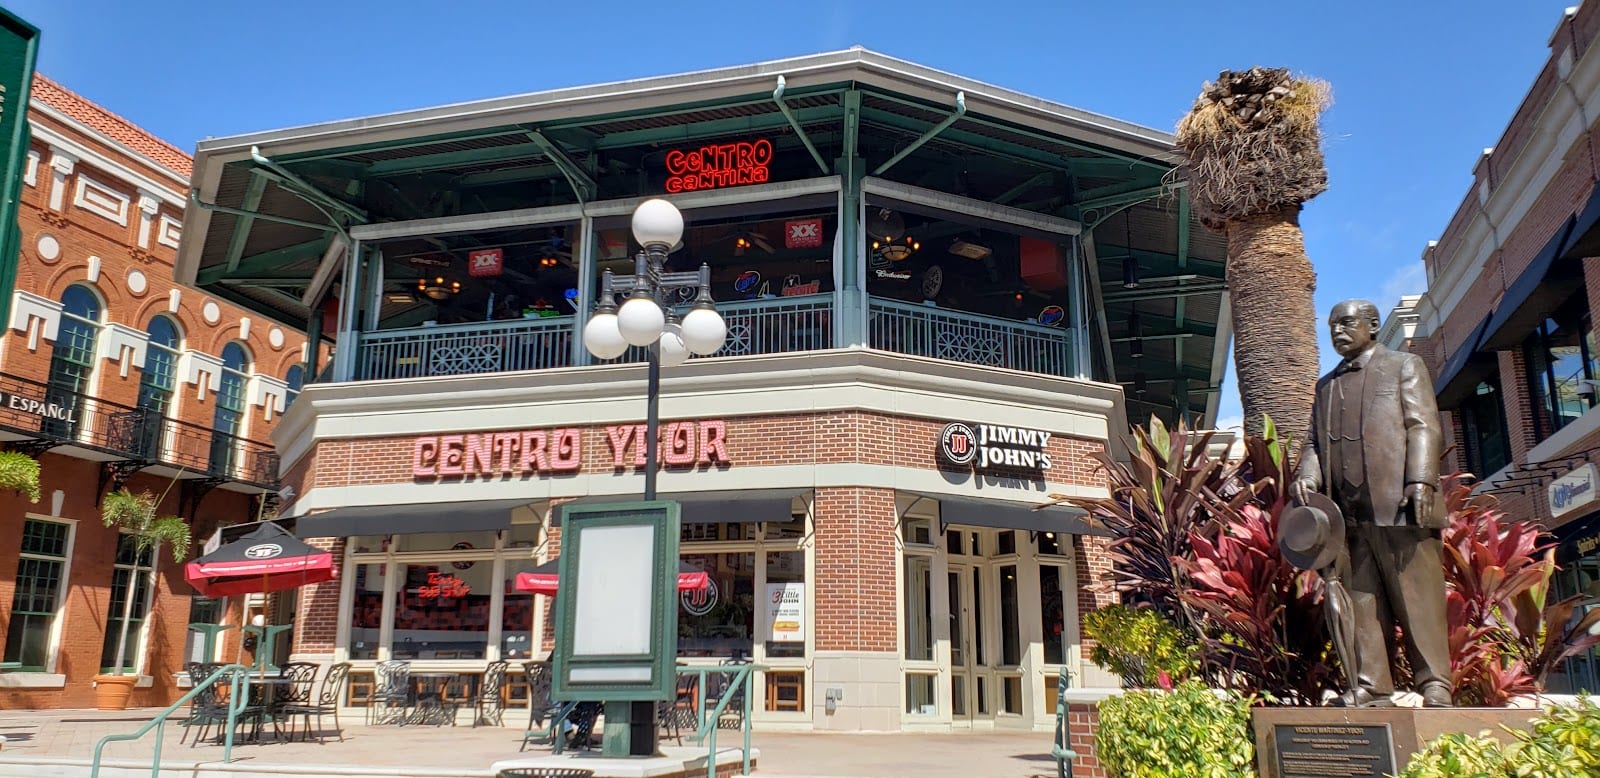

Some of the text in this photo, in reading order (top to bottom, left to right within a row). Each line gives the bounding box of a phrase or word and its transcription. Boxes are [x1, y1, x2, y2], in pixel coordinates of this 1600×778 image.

[951, 433, 967, 454] JJ
[980, 424, 1051, 447] JIMMY
[413, 420, 730, 478] CENTRO YBOR
[980, 446, 1052, 469] JOHN'S
